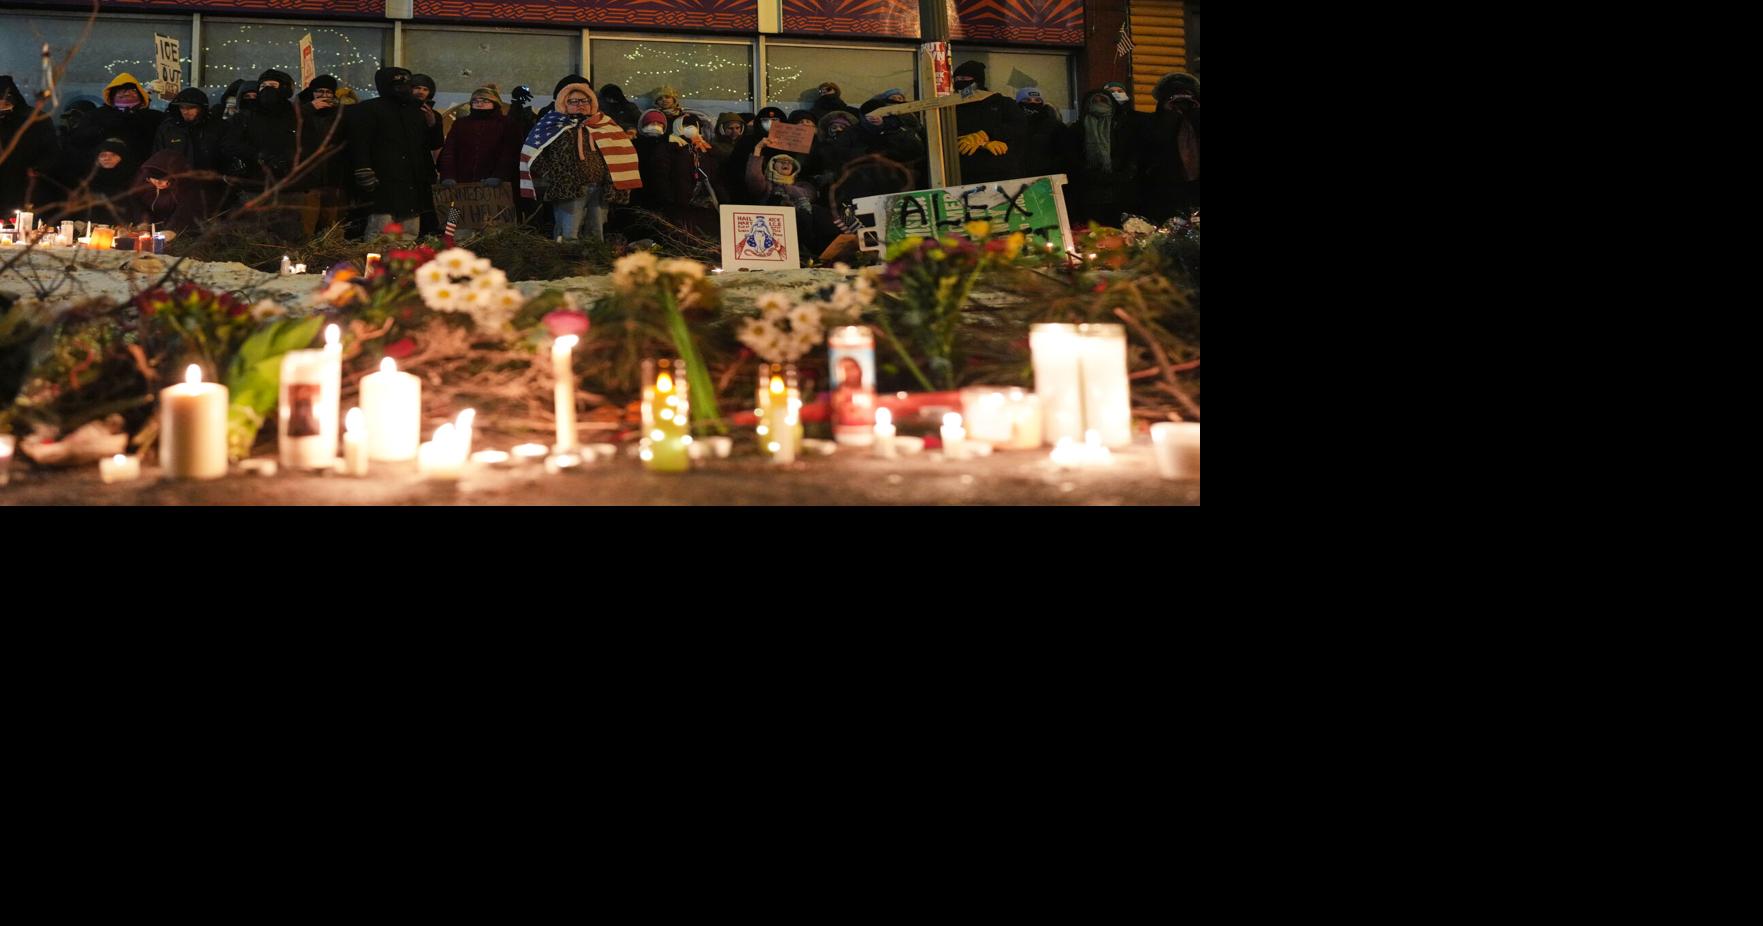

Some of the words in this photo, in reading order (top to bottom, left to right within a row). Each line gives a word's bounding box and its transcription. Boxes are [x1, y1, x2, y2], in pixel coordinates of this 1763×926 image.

[160, 39, 178, 62] ICE
[162, 66, 181, 83] OUT
[900, 184, 1033, 228] ALEX
